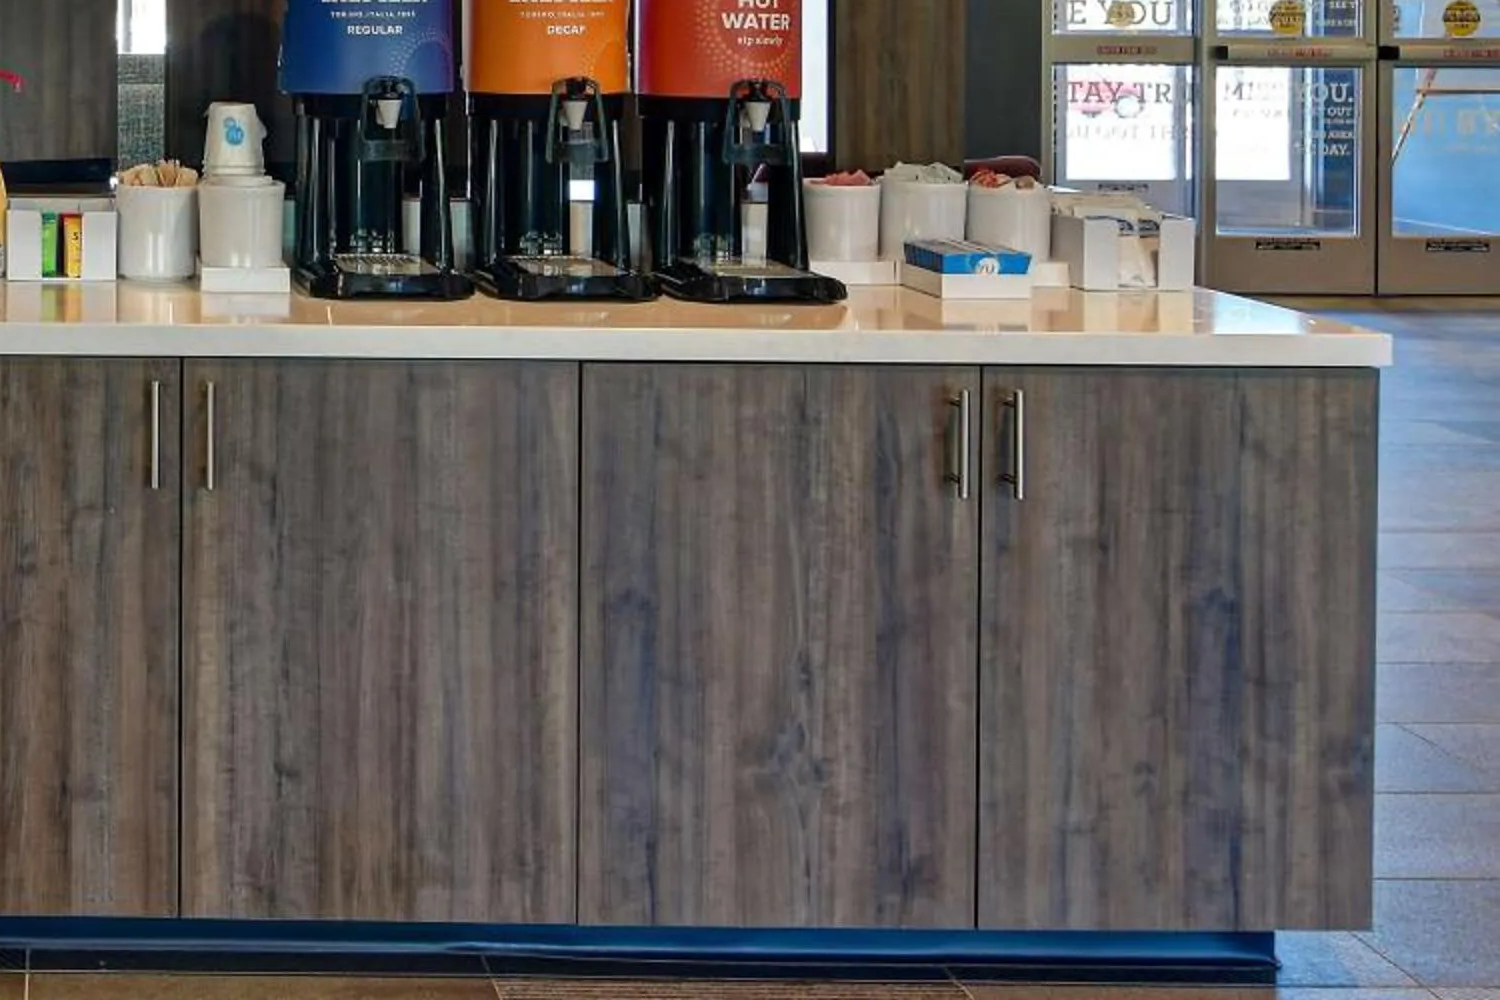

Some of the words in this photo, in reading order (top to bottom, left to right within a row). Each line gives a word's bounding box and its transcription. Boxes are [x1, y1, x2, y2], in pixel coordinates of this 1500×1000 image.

[721, 12, 791, 31] WATER
[1097, 0, 1172, 25] YOU
[347, 25, 403, 35] REGULAR
